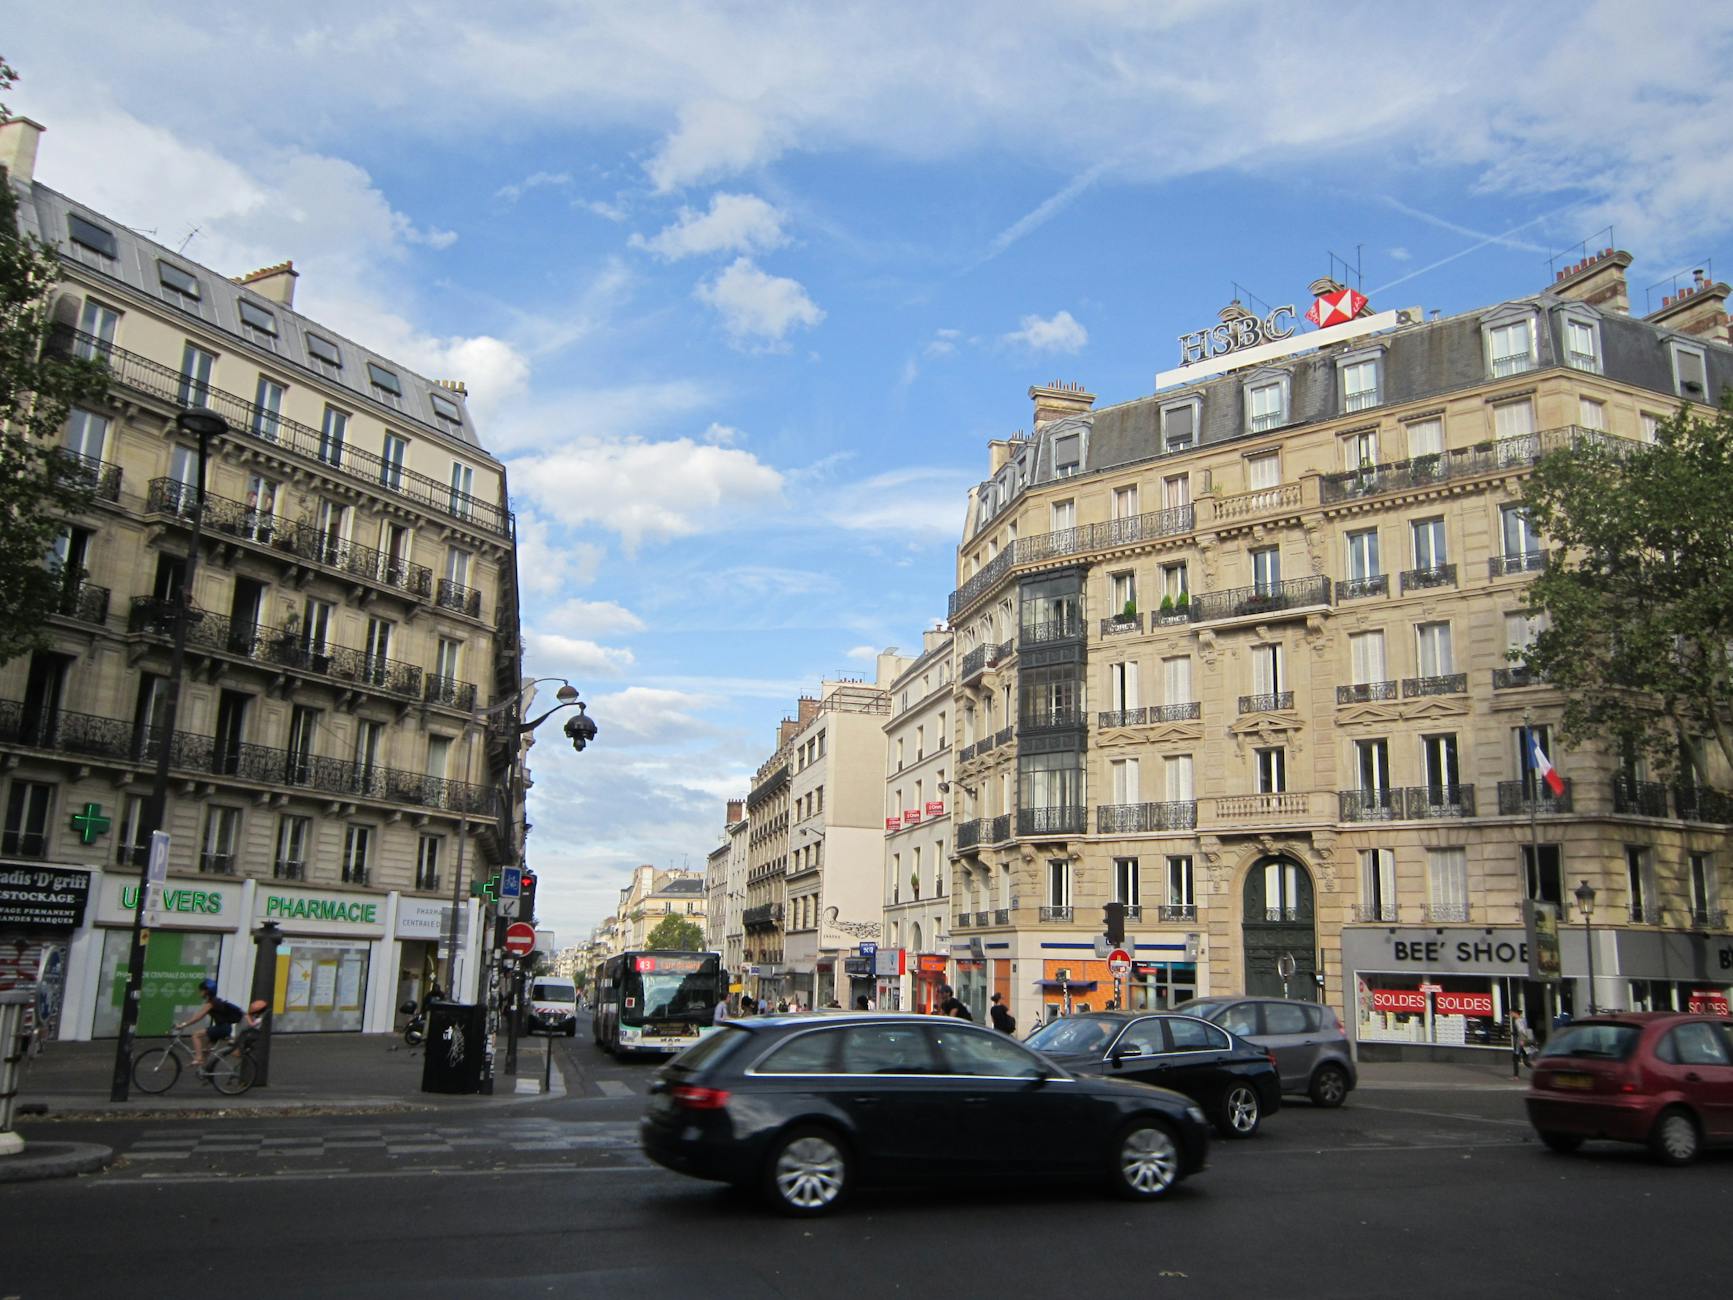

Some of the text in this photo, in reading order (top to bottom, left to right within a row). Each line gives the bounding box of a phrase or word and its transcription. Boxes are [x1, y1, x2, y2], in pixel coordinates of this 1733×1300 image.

[1178, 304, 1296, 367] HSBC
[155, 843, 165, 872] P
[0, 870, 32, 885] adis
[122, 886, 222, 913] UVERS
[24, 908, 75, 916] PERMANENT
[266, 896, 377, 923] PHARMACIE
[33, 916, 74, 924] MARQUES
[1394, 941, 1446, 961] BEE'
[639, 960, 650, 970] 43
[1374, 993, 1425, 1007] SOLDES
[1437, 997, 1492, 1011] SOLDES
